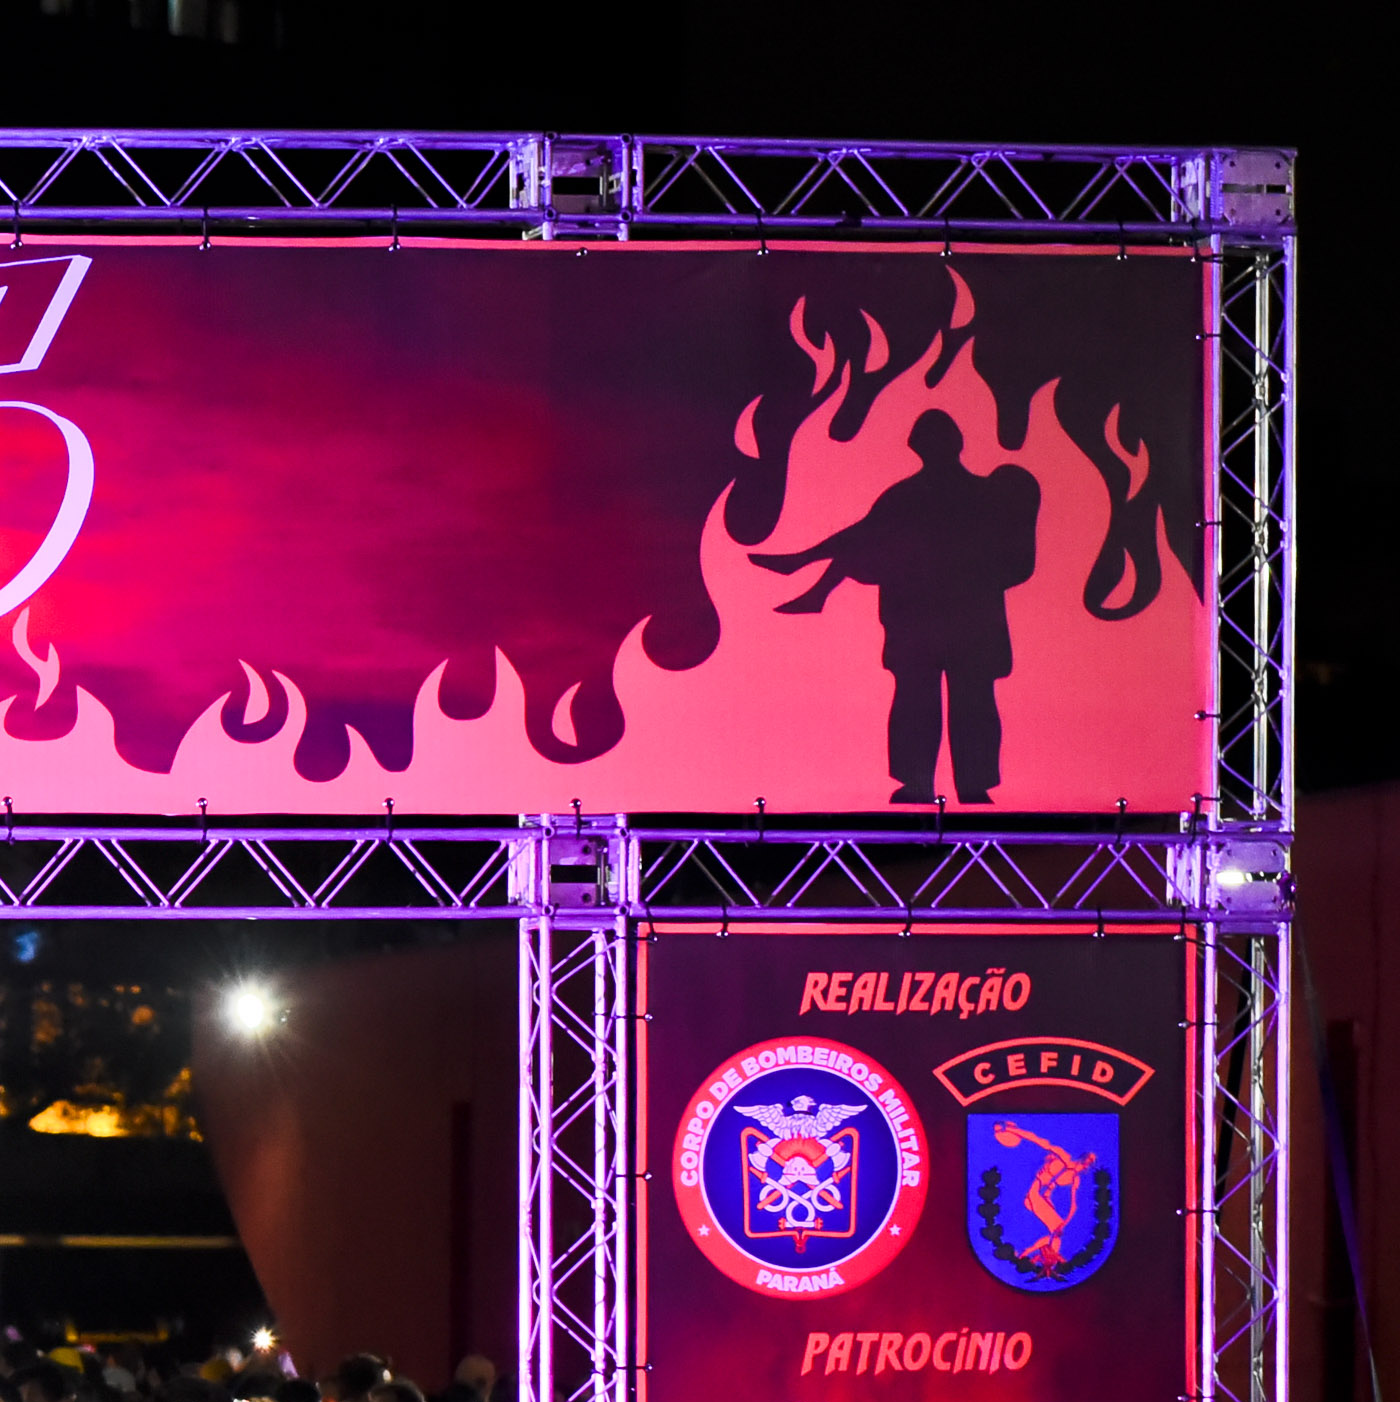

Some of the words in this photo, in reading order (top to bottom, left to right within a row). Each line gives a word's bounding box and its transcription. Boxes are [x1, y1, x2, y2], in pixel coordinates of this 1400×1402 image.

[800, 968, 1031, 1018] REALIZAÇÃO
[974, 1052, 1115, 1084] CEFID
[680, 1100, 715, 1187] CORPO
[709, 1068, 743, 1101] DE
[740, 1046, 883, 1093] BOMBEIROS
[878, 1089, 921, 1187] MILITAR
[755, 1267, 845, 1292] PARANÁ
[801, 1327, 1032, 1375] PATROCÍNIO
